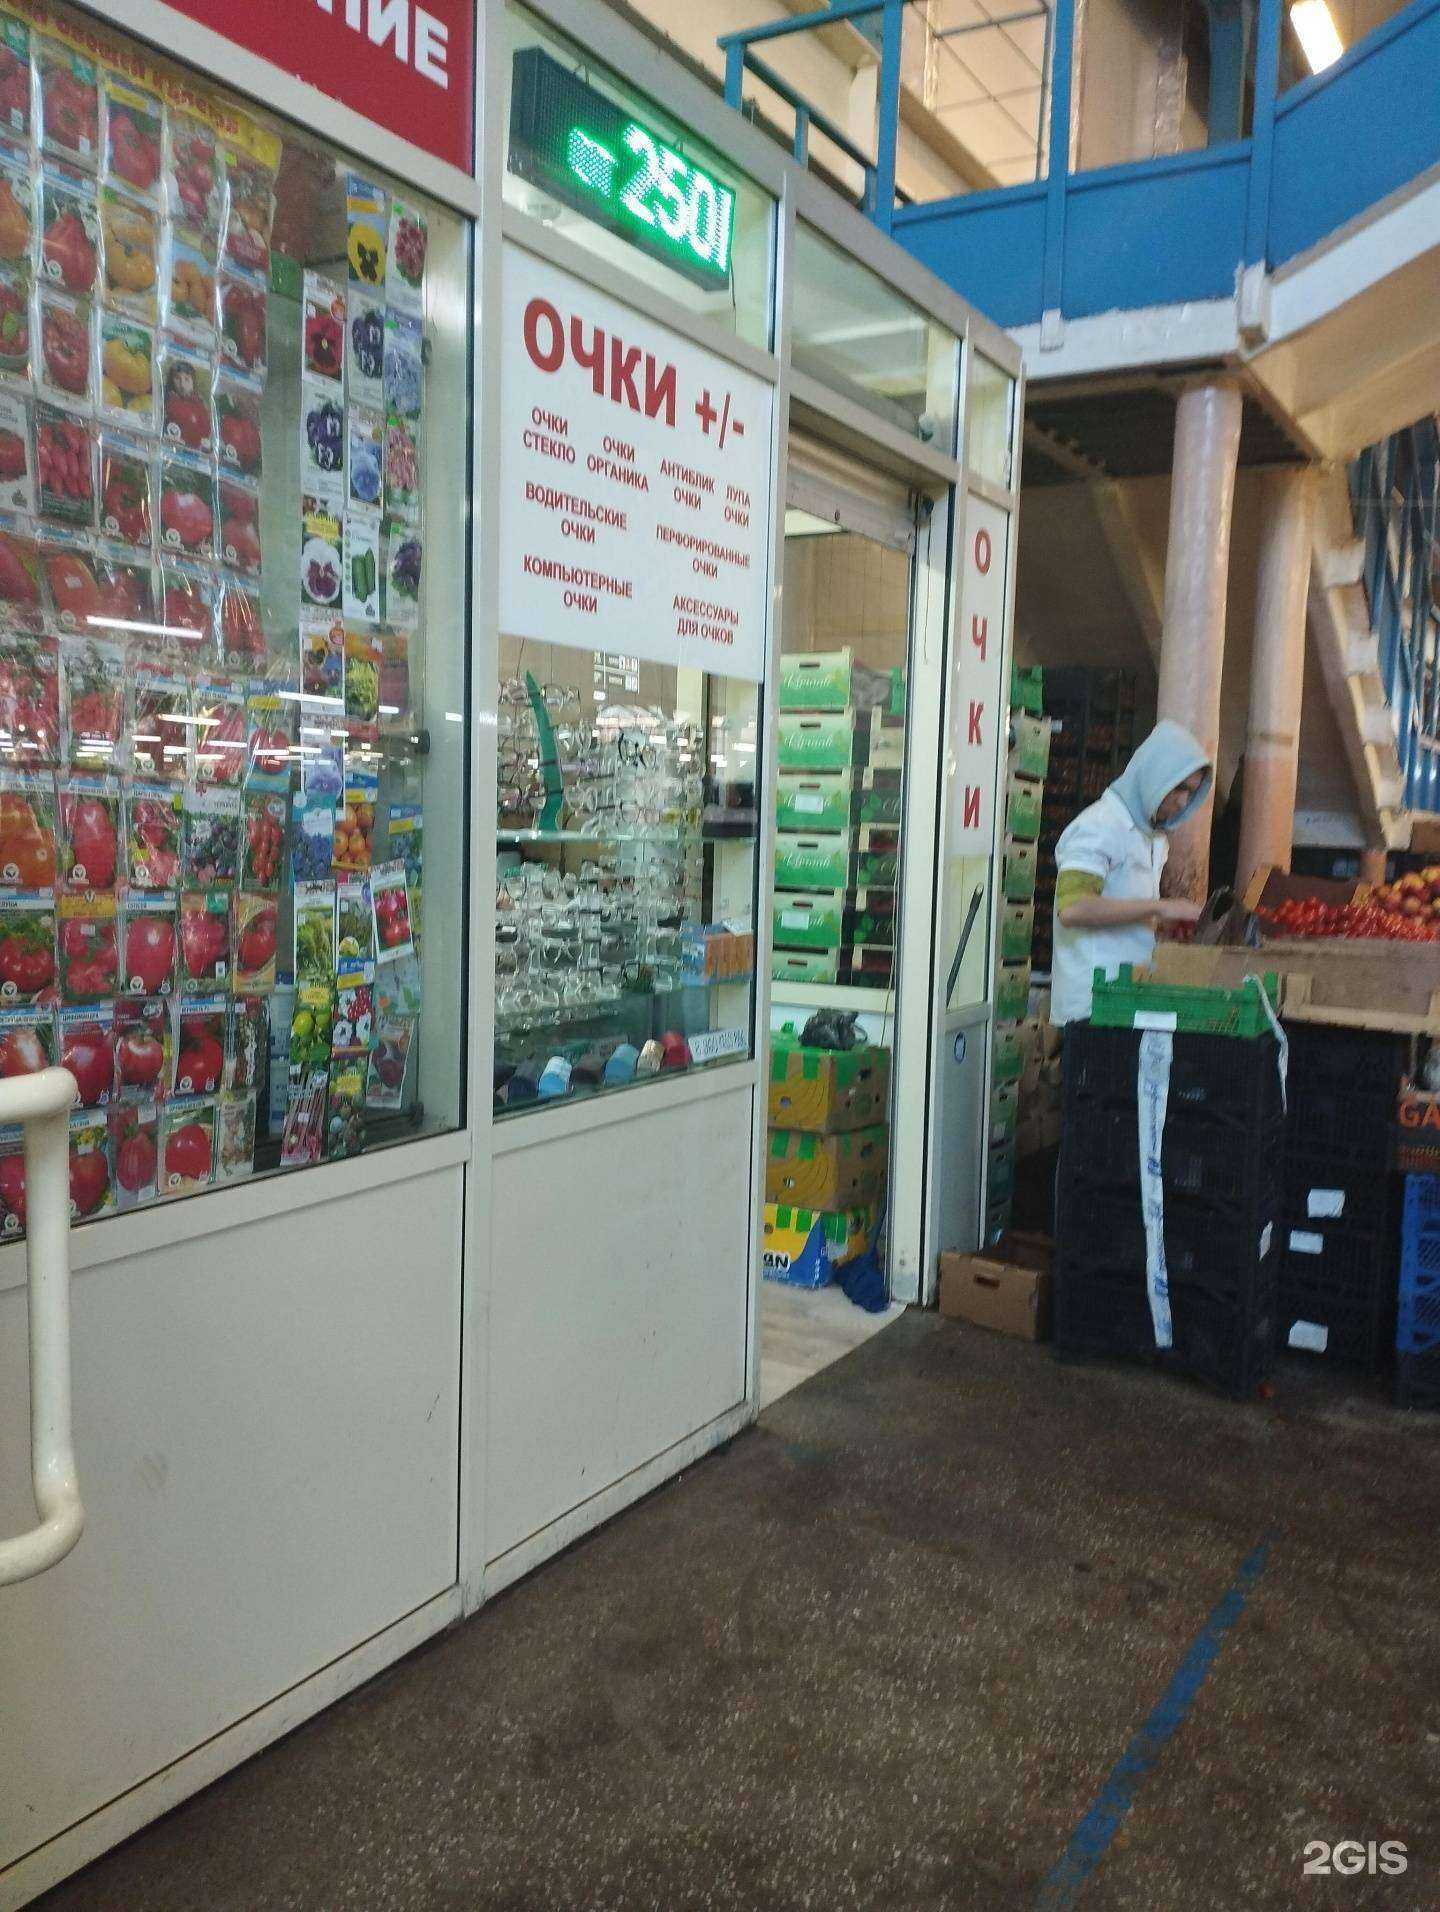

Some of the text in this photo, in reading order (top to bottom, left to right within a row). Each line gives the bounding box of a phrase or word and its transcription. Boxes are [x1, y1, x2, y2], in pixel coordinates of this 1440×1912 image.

[523, 297, 745, 449] ОЧКИ +/-
[531, 406, 568, 436] ОЧКИ
[523, 430, 576, 464] СТЕКЛО
[602, 435, 635, 462] ОЧКИ
[586, 453, 649, 493] ОРГАНИКА
[660, 458, 715, 495] АНТИБЛИК
[525, 480, 627, 530] ВОДИТЕЛЬСКИЕ
[673, 486, 702, 511] ОЧКИ
[560, 518, 596, 544] ОЧКИ
[724, 505, 749, 528] ОЧКИ
[656, 524, 751, 569] ПЕРФОРИРОВАННЫЕ
[523, 554, 633, 600] КОМПЬЮТЕРНЫЕ
[692, 558, 718, 579] ОЧКИ
[563, 590, 598, 613] ОЧКИ
[673, 595, 739, 626] АКСЕССУАРЫ
[677, 617, 734, 646] ДЛЯ ОЧКОВ
[963, 528, 992, 829] ОЧКИ
